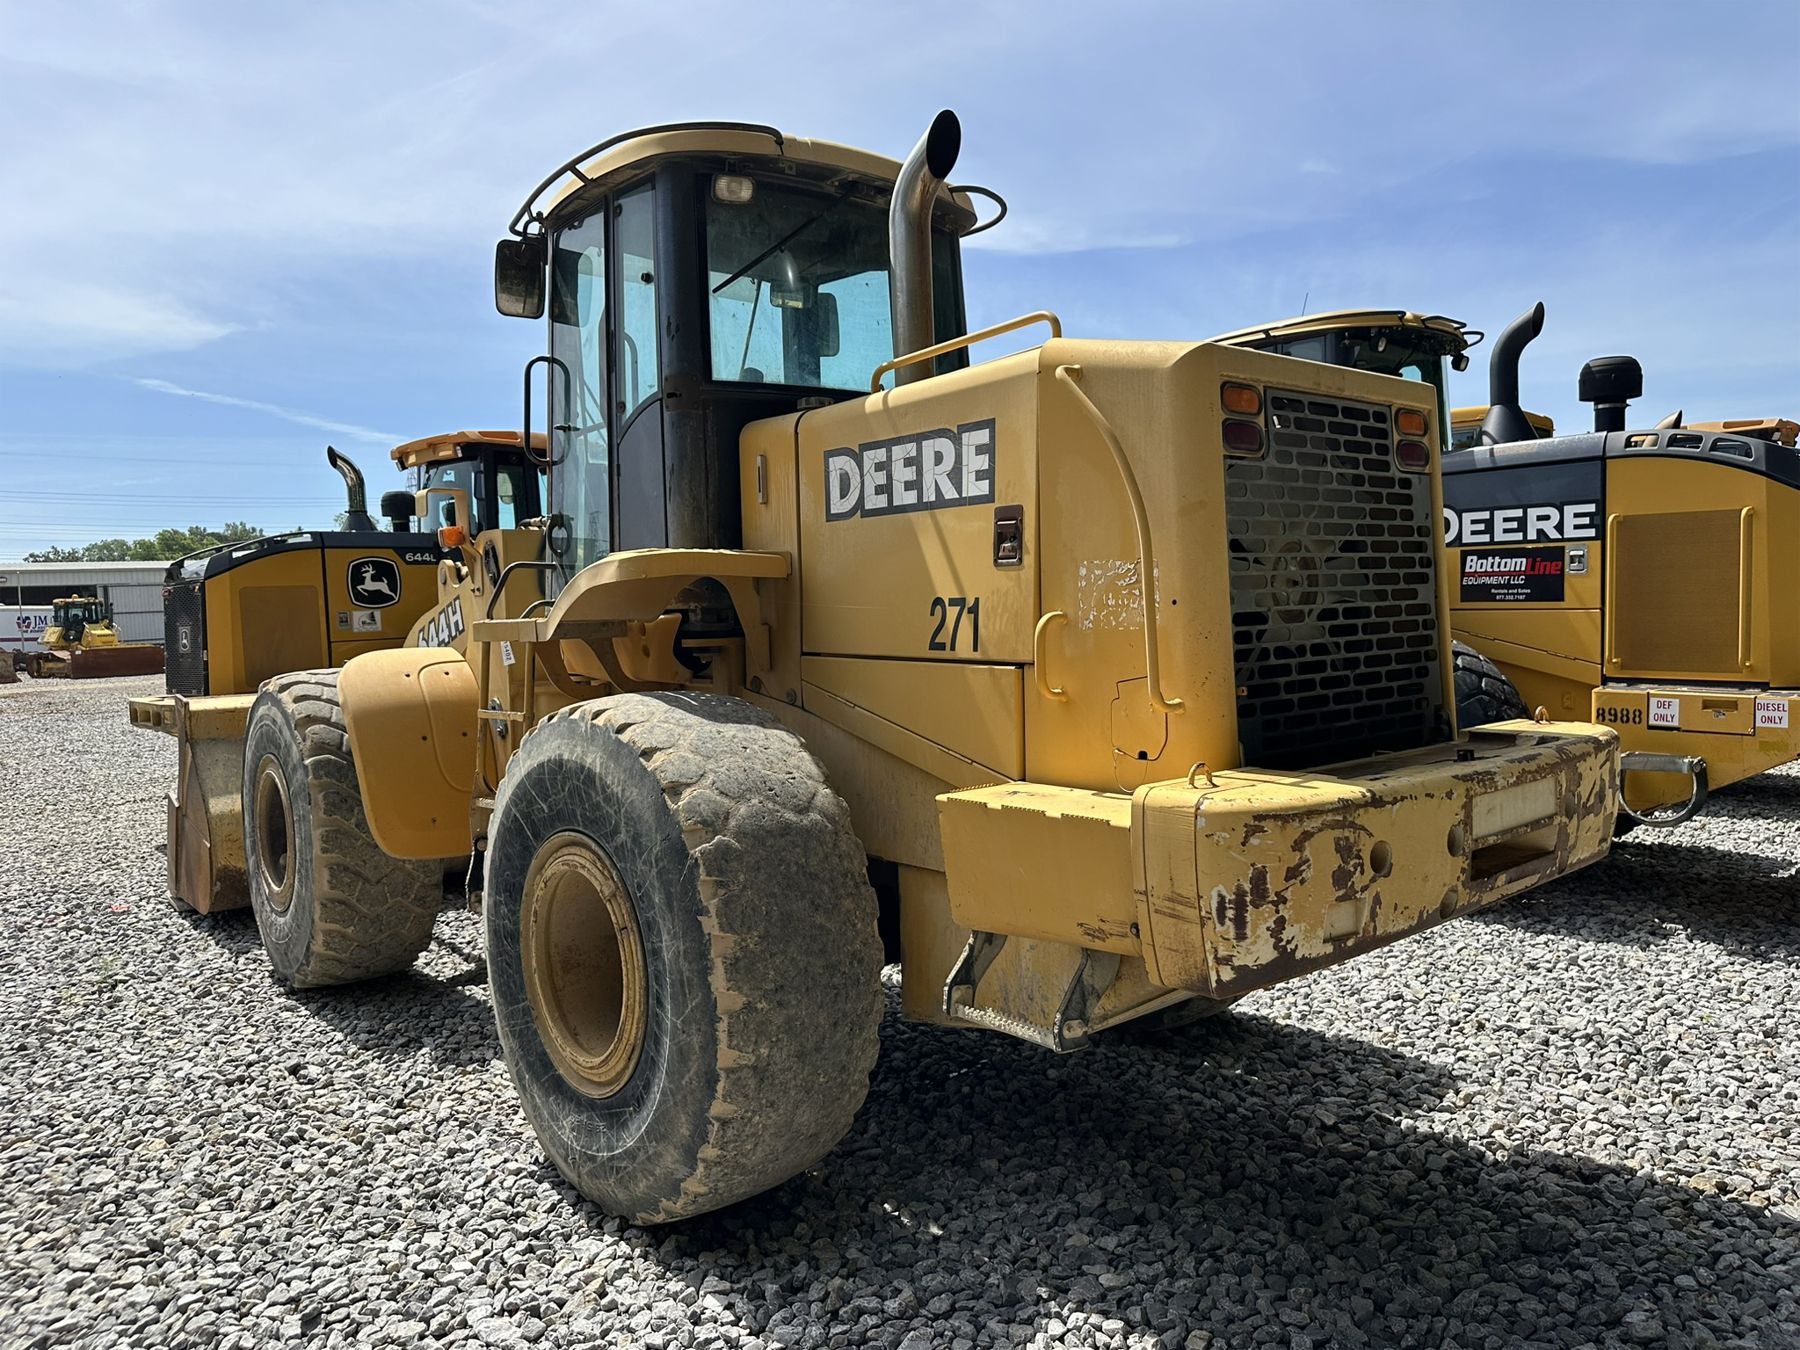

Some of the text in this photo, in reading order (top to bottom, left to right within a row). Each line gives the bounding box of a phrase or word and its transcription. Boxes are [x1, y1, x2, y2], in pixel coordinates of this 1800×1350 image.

[828, 427, 990, 515] DEERE
[405, 552, 437, 562] 644L
[1462, 575, 1526, 585] EQUIPMENT LLC
[32, 615, 48, 629] JM
[417, 597, 464, 648] 644H
[928, 597, 980, 653] 271
[1656, 700, 1673, 710] DEF
[1756, 702, 1788, 713] DIESEL
[1596, 707, 1643, 725] 8988
[1653, 711, 1676, 723] ONLY
[1760, 714, 1784, 725] ONLY
